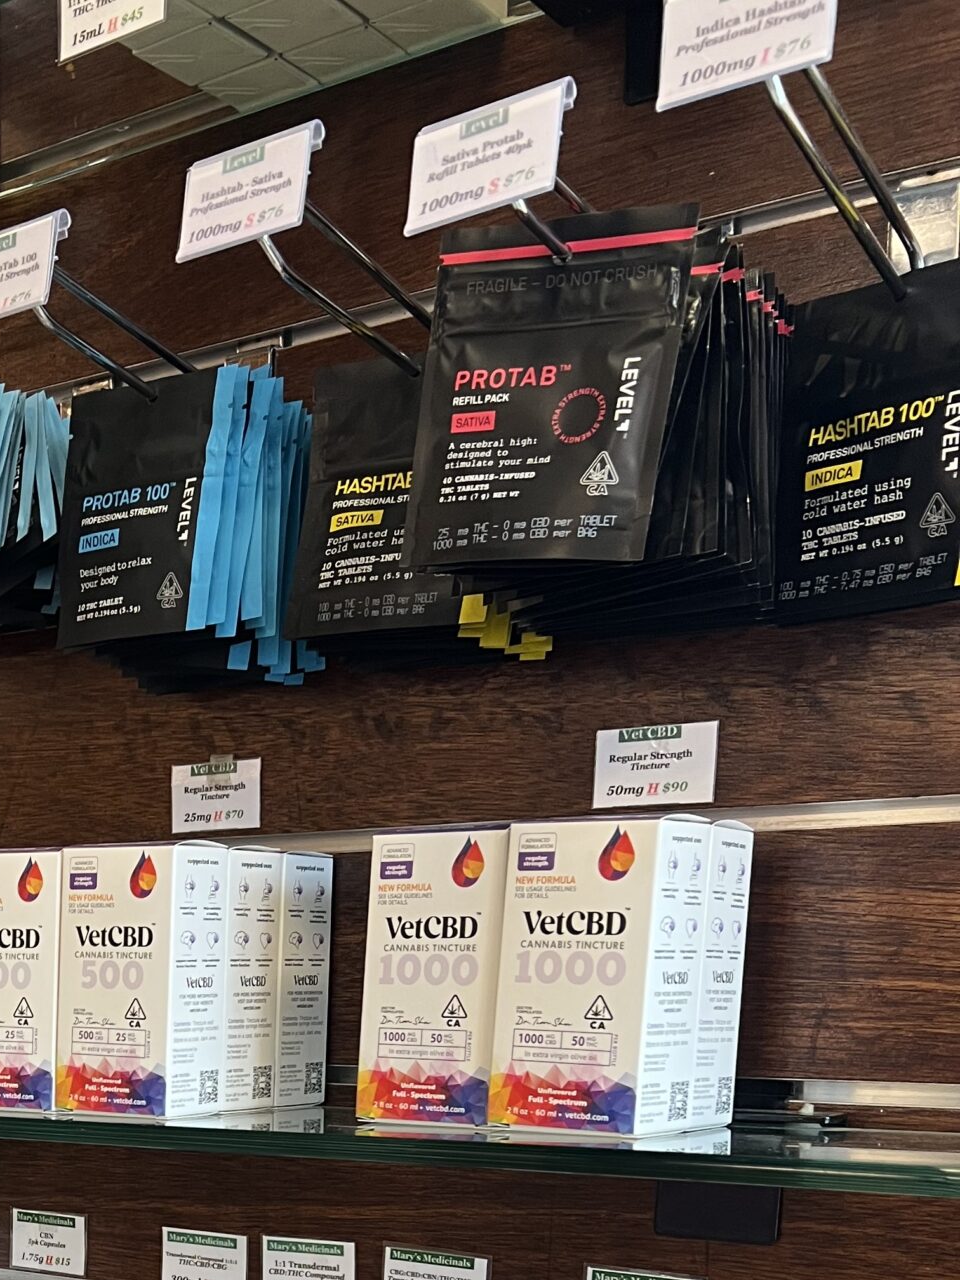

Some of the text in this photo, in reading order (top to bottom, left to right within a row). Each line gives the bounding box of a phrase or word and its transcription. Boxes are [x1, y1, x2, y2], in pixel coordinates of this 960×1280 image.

[441, 130, 524, 166] Sativa Protab
[419, 167, 535, 216] 1000mg S $76
[467, 265, 658, 296] FRAGILE DO NOT CRUSH
[614, 357, 642, 420] LEVEL
[453, 393, 510, 406] REFILL PACK
[455, 416, 491, 428] SATIVA
[808, 408, 895, 447] HASHTAB
[447, 450, 492, 459] designed
[807, 427, 924, 464] PROFESSIONAL STRENGTH
[811, 466, 853, 486] INDICA
[804, 477, 912, 509] Formulated using
[803, 490, 903, 520] cold water hash
[82, 533, 115, 549] INDICA
[80, 556, 152, 578] Designed to relax
[81, 575, 118, 592] your body
[609, 749, 693, 765] Regular Strength
[630, 761, 671, 771] Tincture
[184, 782, 246, 795] Regular Strength
[200, 792, 230, 801] Tincture
[607, 784, 644, 797] 50mg
[662, 781, 688, 793] $90
[184, 811, 212, 824] 25mg
[225, 809, 244, 821] $70
[386, 915, 477, 939] VetCBD
[524, 910, 626, 937] VetCBD
[76, 925, 153, 948] VetCBD
[520, 940, 624, 950] CANNABIS TINCTURE
[75, 951, 152, 960] CANNABIS TINCTURE
[384, 943, 476, 952] CANNABIS TINCTURE
[81, 961, 144, 990] 500
[378, 954, 479, 986] 1000
[514, 951, 626, 986] 1000
[392, 1251, 471, 1267] Mary's Medicinals
